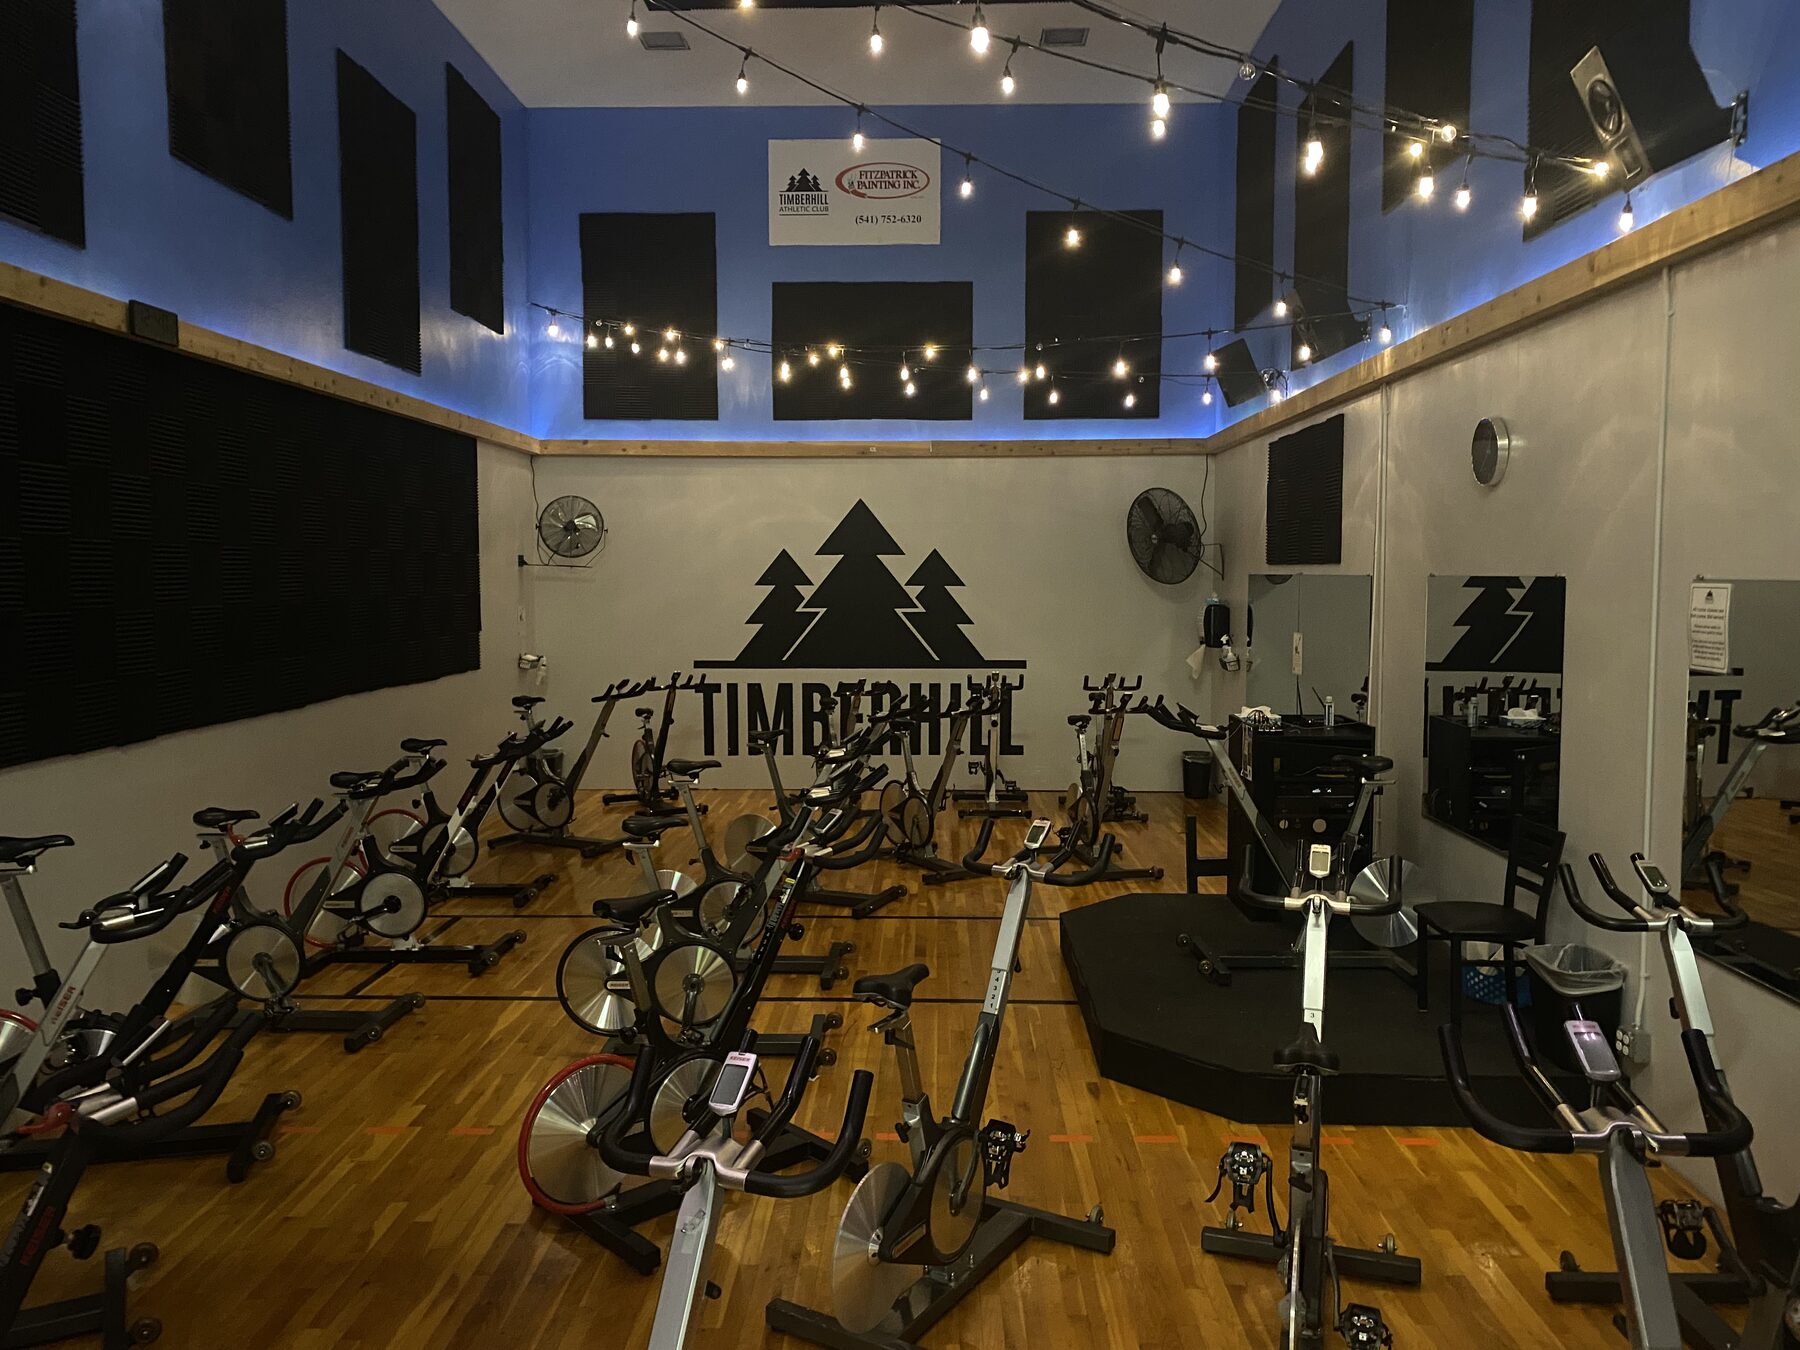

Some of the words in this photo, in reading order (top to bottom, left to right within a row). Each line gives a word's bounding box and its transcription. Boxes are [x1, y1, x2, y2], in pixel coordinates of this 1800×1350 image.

[859, 170, 918, 180] FITZPATRICK
[857, 180, 901, 190] PAINTING
[903, 180, 921, 190] INC.
[779, 193, 829, 205] TIMBERHILL
[855, 215, 879, 225] (541)
[881, 215, 922, 224] 752-6320
